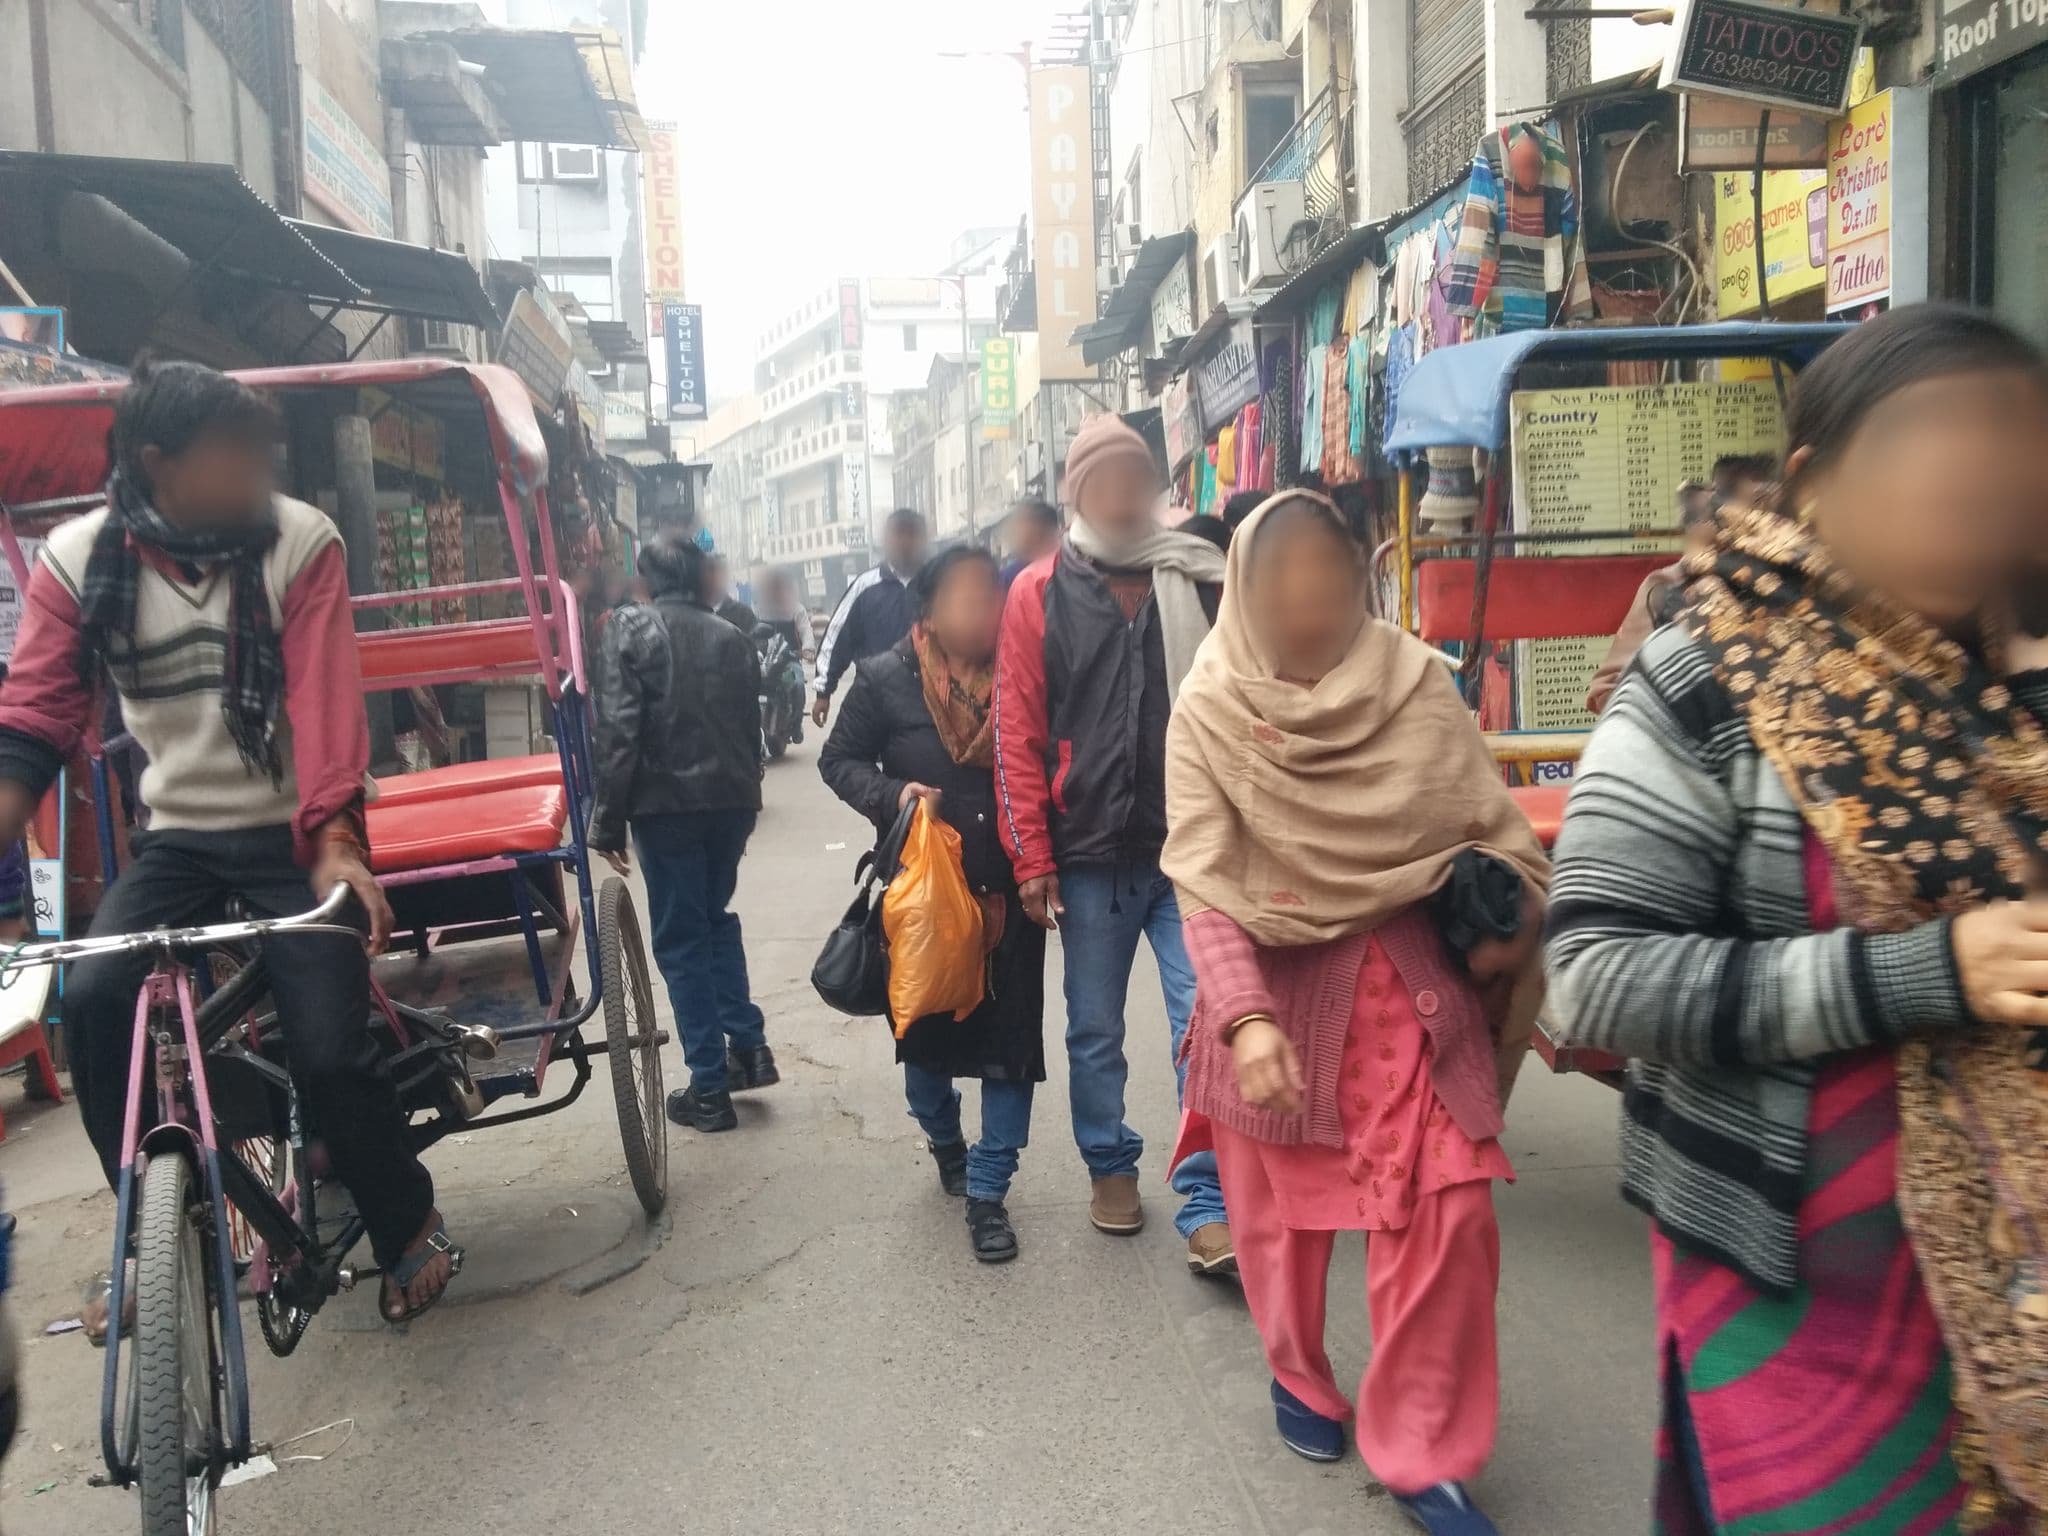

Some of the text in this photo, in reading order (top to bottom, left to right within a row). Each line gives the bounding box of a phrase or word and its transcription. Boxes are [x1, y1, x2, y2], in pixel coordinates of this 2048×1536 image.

[1704, 11, 1843, 68] TATTOO'S
[1943, 1, 1999, 63] Roof
[1701, 49, 1831, 93] 7838534772
[1833, 112, 1887, 161] Lord
[1830, 156, 1888, 202] Krishna
[651, 132, 680, 289] SHELTON
[1048, 83, 1080, 316] PAYAL
[1832, 253, 1885, 297] Tattoo
[667, 305, 701, 316] HOTEL
[677, 315, 695, 402] SHELTON
[985, 339, 1009, 409] GURU
[1550, 394, 1582, 407] New
[1589, 390, 1620, 404] Post
[1674, 385, 1713, 400] Price
[1717, 384, 1757, 396] India
[1526, 410, 1599, 425] Country
[1527, 428, 1599, 440] AUSTRALIA
[1528, 440, 1583, 451] AUSTRIA
[1528, 450, 1586, 462] BELGIUM
[1535, 643, 1586, 654] NIGERIA
[1535, 654, 1586, 664] POLAND
[1536, 675, 1582, 686] RUSSIA
[1536, 697, 1573, 707] SPAIN
